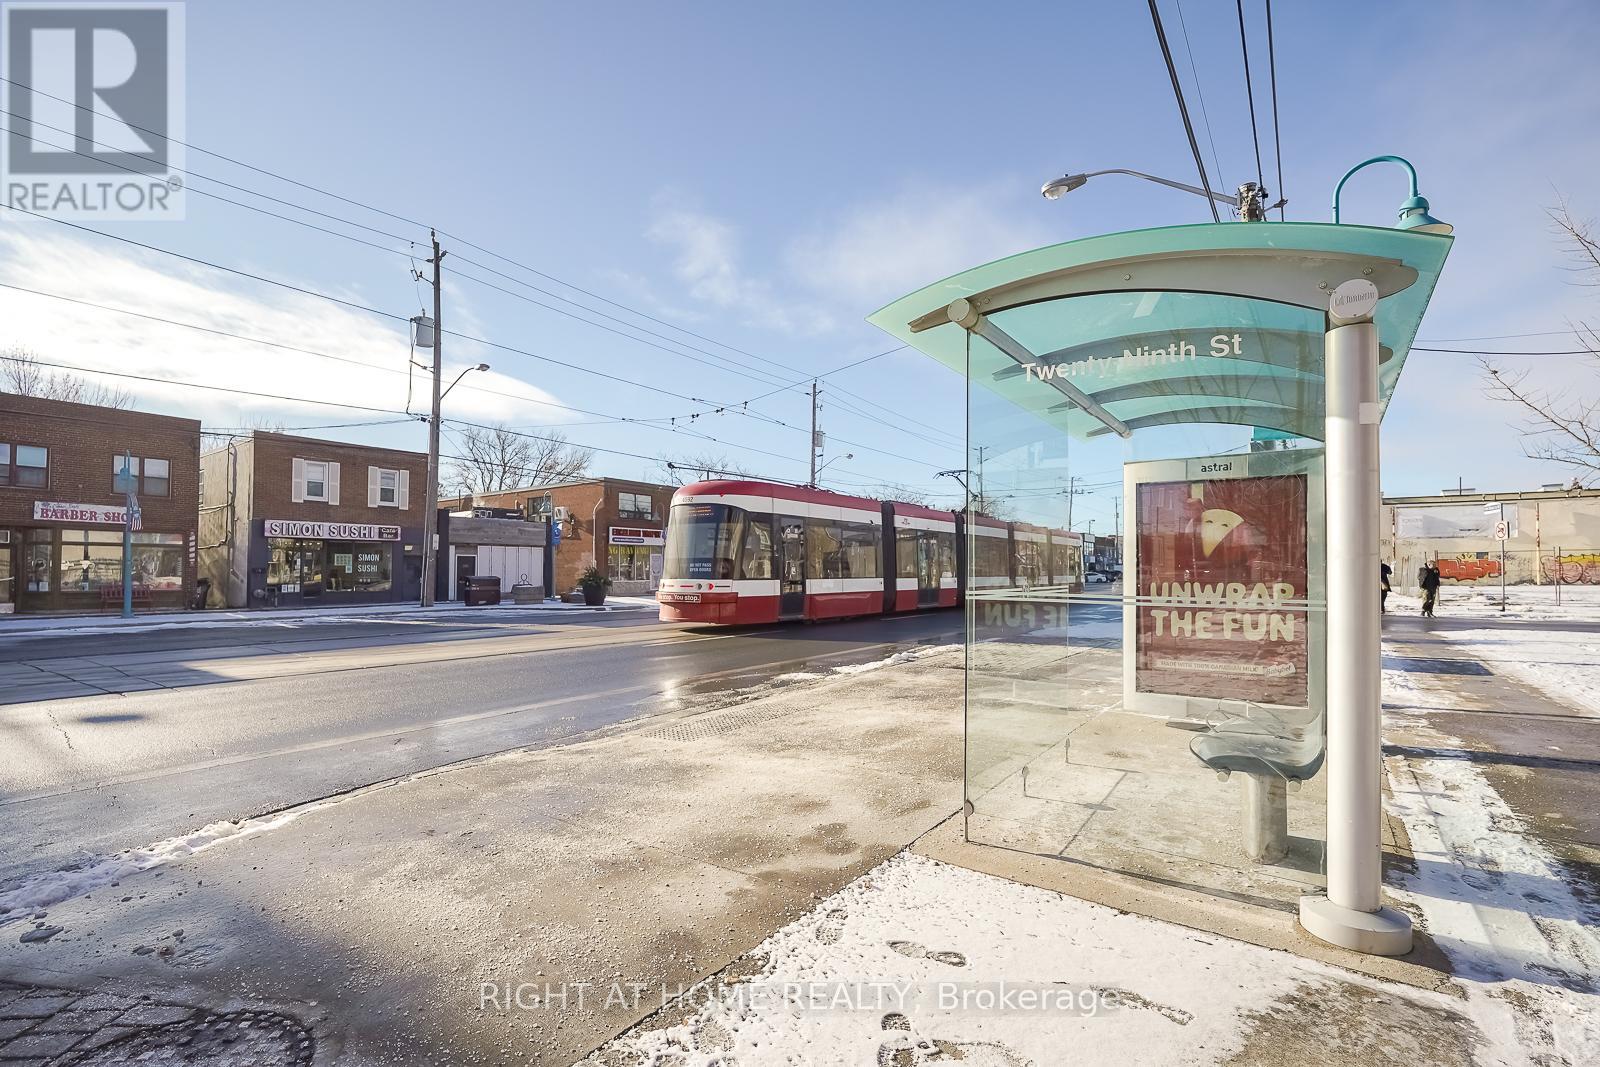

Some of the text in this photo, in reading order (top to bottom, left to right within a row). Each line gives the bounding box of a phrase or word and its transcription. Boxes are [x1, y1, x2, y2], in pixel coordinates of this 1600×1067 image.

[1209, 333, 1243, 358] St
[1200, 462, 1232, 473] astral
[40, 508, 128, 523] BARBER SHO
[269, 521, 375, 539] SIMON SUSHI
[358, 553, 380, 563] SIMON
[357, 564, 378, 573] SUSHI
[674, 593, 684, 601] You
[684, 594, 700, 603] stop.
[1151, 581, 1295, 606] UNWRAP
[1150, 609, 1295, 642] THE FUN
[1242, 664, 1259, 673] MILK
